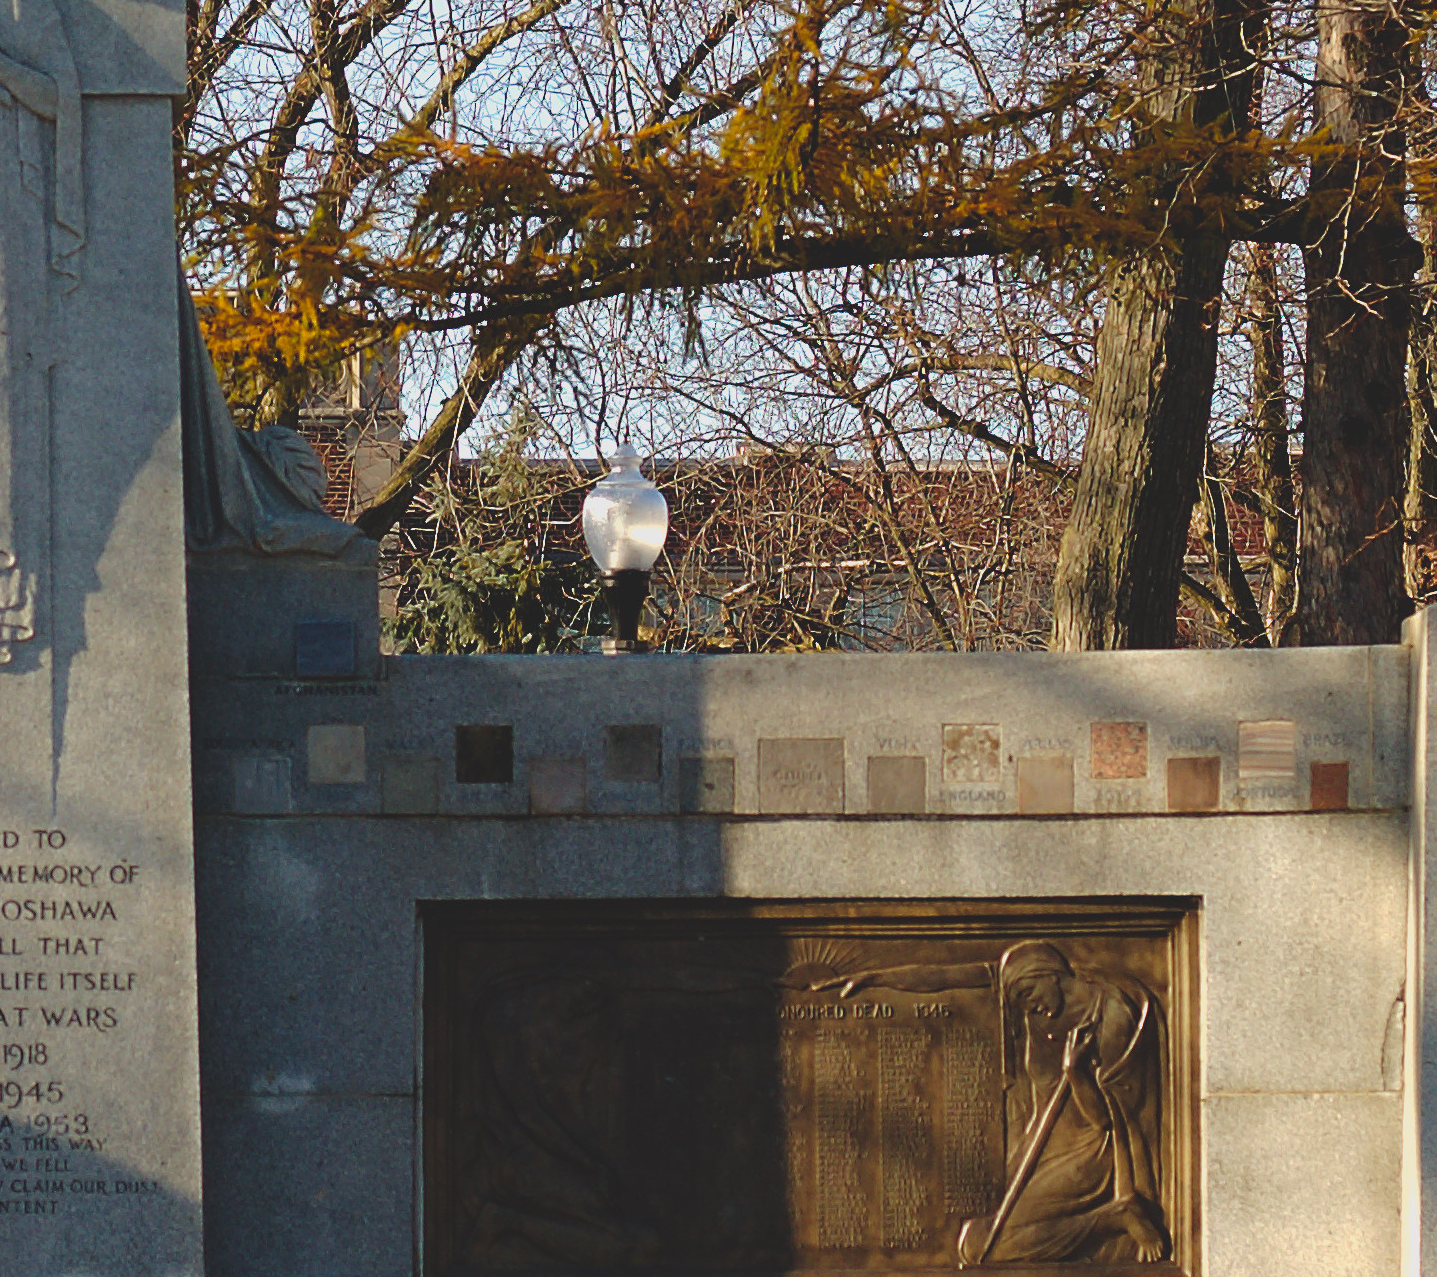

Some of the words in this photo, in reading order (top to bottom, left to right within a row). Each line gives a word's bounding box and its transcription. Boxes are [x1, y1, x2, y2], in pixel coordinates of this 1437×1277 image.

[33, 830, 67, 850] TO
[109, 864, 141, 886] OF
[1, 899, 118, 922] OSHAWA
[37, 936, 104, 956] THAT
[0, 972, 49, 991] LIFE
[59, 971, 137, 992] ITSELF
[40, 1007, 118, 1032] WARS
[852, 1003, 894, 1020] DEAD
[3, 1042, 48, 1070] 1918
[26, 1113, 90, 1136] 1953
[23, 1137, 59, 1151] THIS
[69, 1136, 107, 1152] WAY
[35, 1158, 72, 1172] FELL
[10, 1178, 64, 1194] CLAIM
[70, 1178, 108, 1196] OUR
